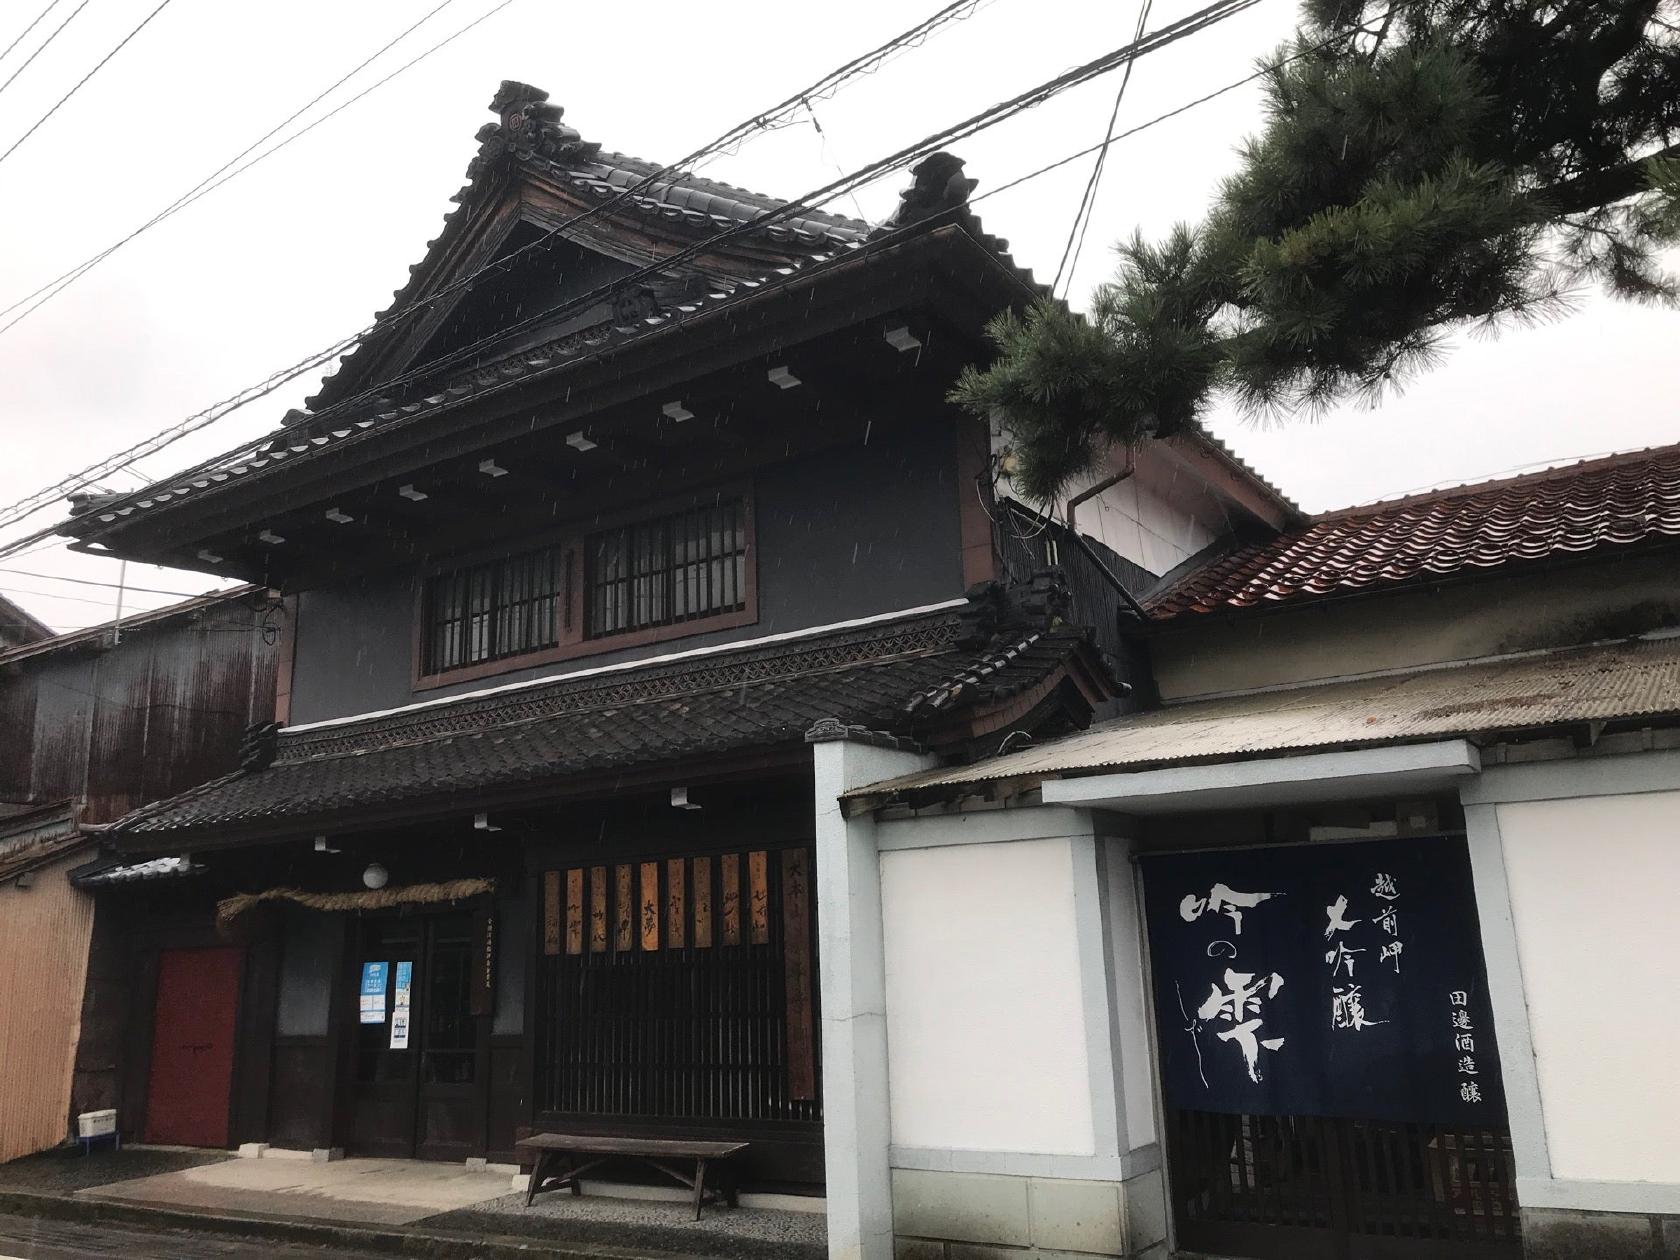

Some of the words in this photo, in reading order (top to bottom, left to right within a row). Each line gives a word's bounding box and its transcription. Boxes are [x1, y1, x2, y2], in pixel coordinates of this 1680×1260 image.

[1179, 882, 1287, 1084] 吟の雫
[1370, 872, 1404, 974] 越前岬
